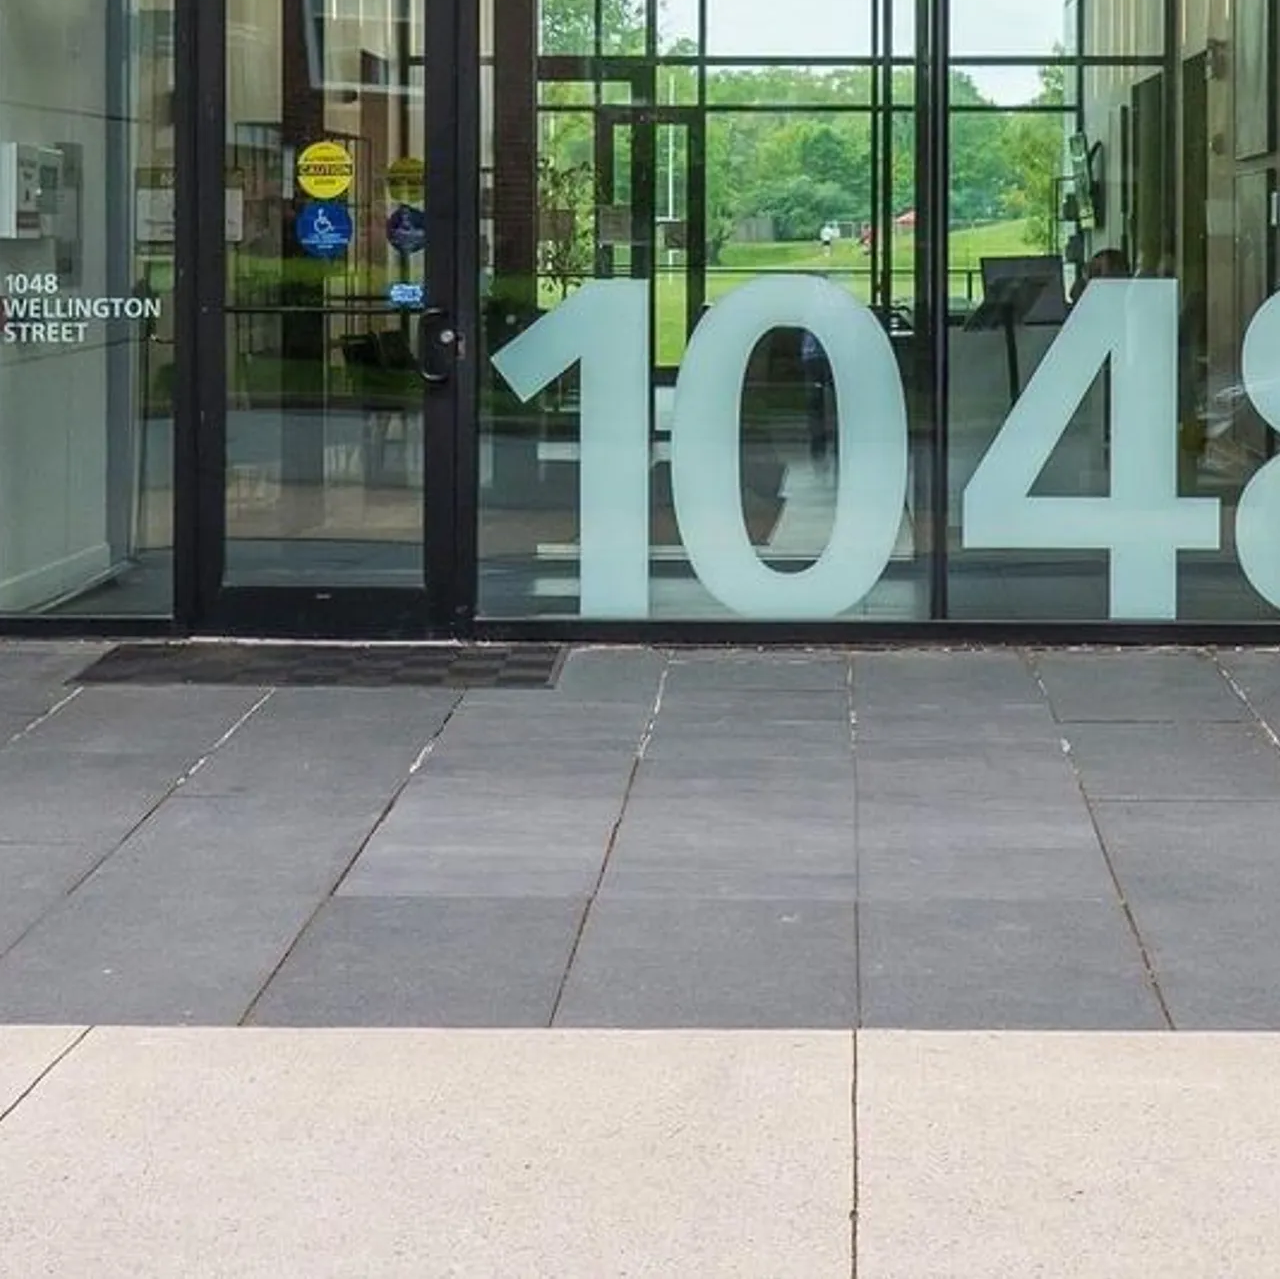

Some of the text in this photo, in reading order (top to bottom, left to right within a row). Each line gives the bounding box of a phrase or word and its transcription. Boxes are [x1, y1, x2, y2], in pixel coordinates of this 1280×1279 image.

[6, 273, 58, 294] 1048
[3, 297, 161, 319] WELLINGTON
[3, 322, 88, 343] STREET
